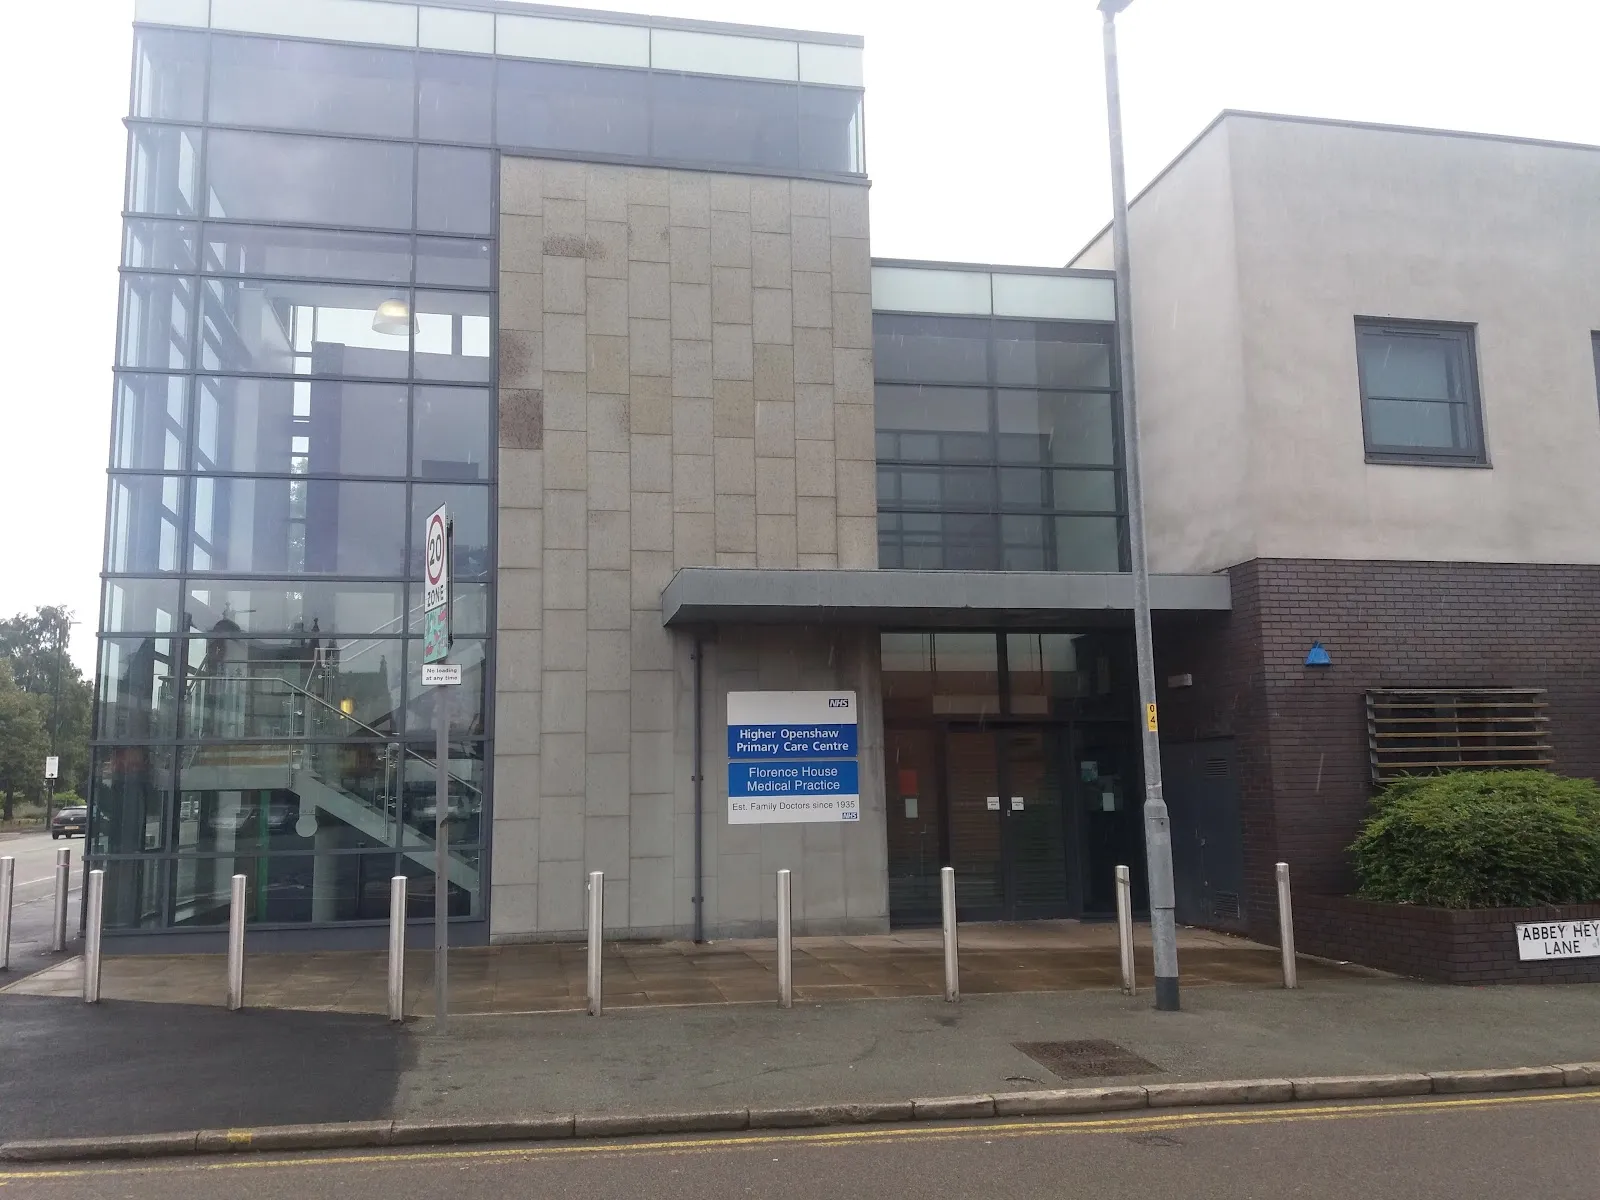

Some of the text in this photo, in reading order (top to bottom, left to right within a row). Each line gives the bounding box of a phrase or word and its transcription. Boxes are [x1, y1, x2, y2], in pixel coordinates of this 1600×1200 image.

[429, 534, 442, 567] 20
[427, 585, 444, 607] ZONE
[829, 699, 848, 707] NHS
[740, 728, 839, 741] Higher Openshaw
[736, 741, 849, 754] Primary Care Centre
[749, 766, 838, 778] Florence House
[747, 780, 840, 792] Medical Practice
[732, 800, 855, 812] Est. Family Doctors since 1935
[1523, 924, 1599, 940] ABBEY HEY
[1544, 940, 1581, 955] LANE
